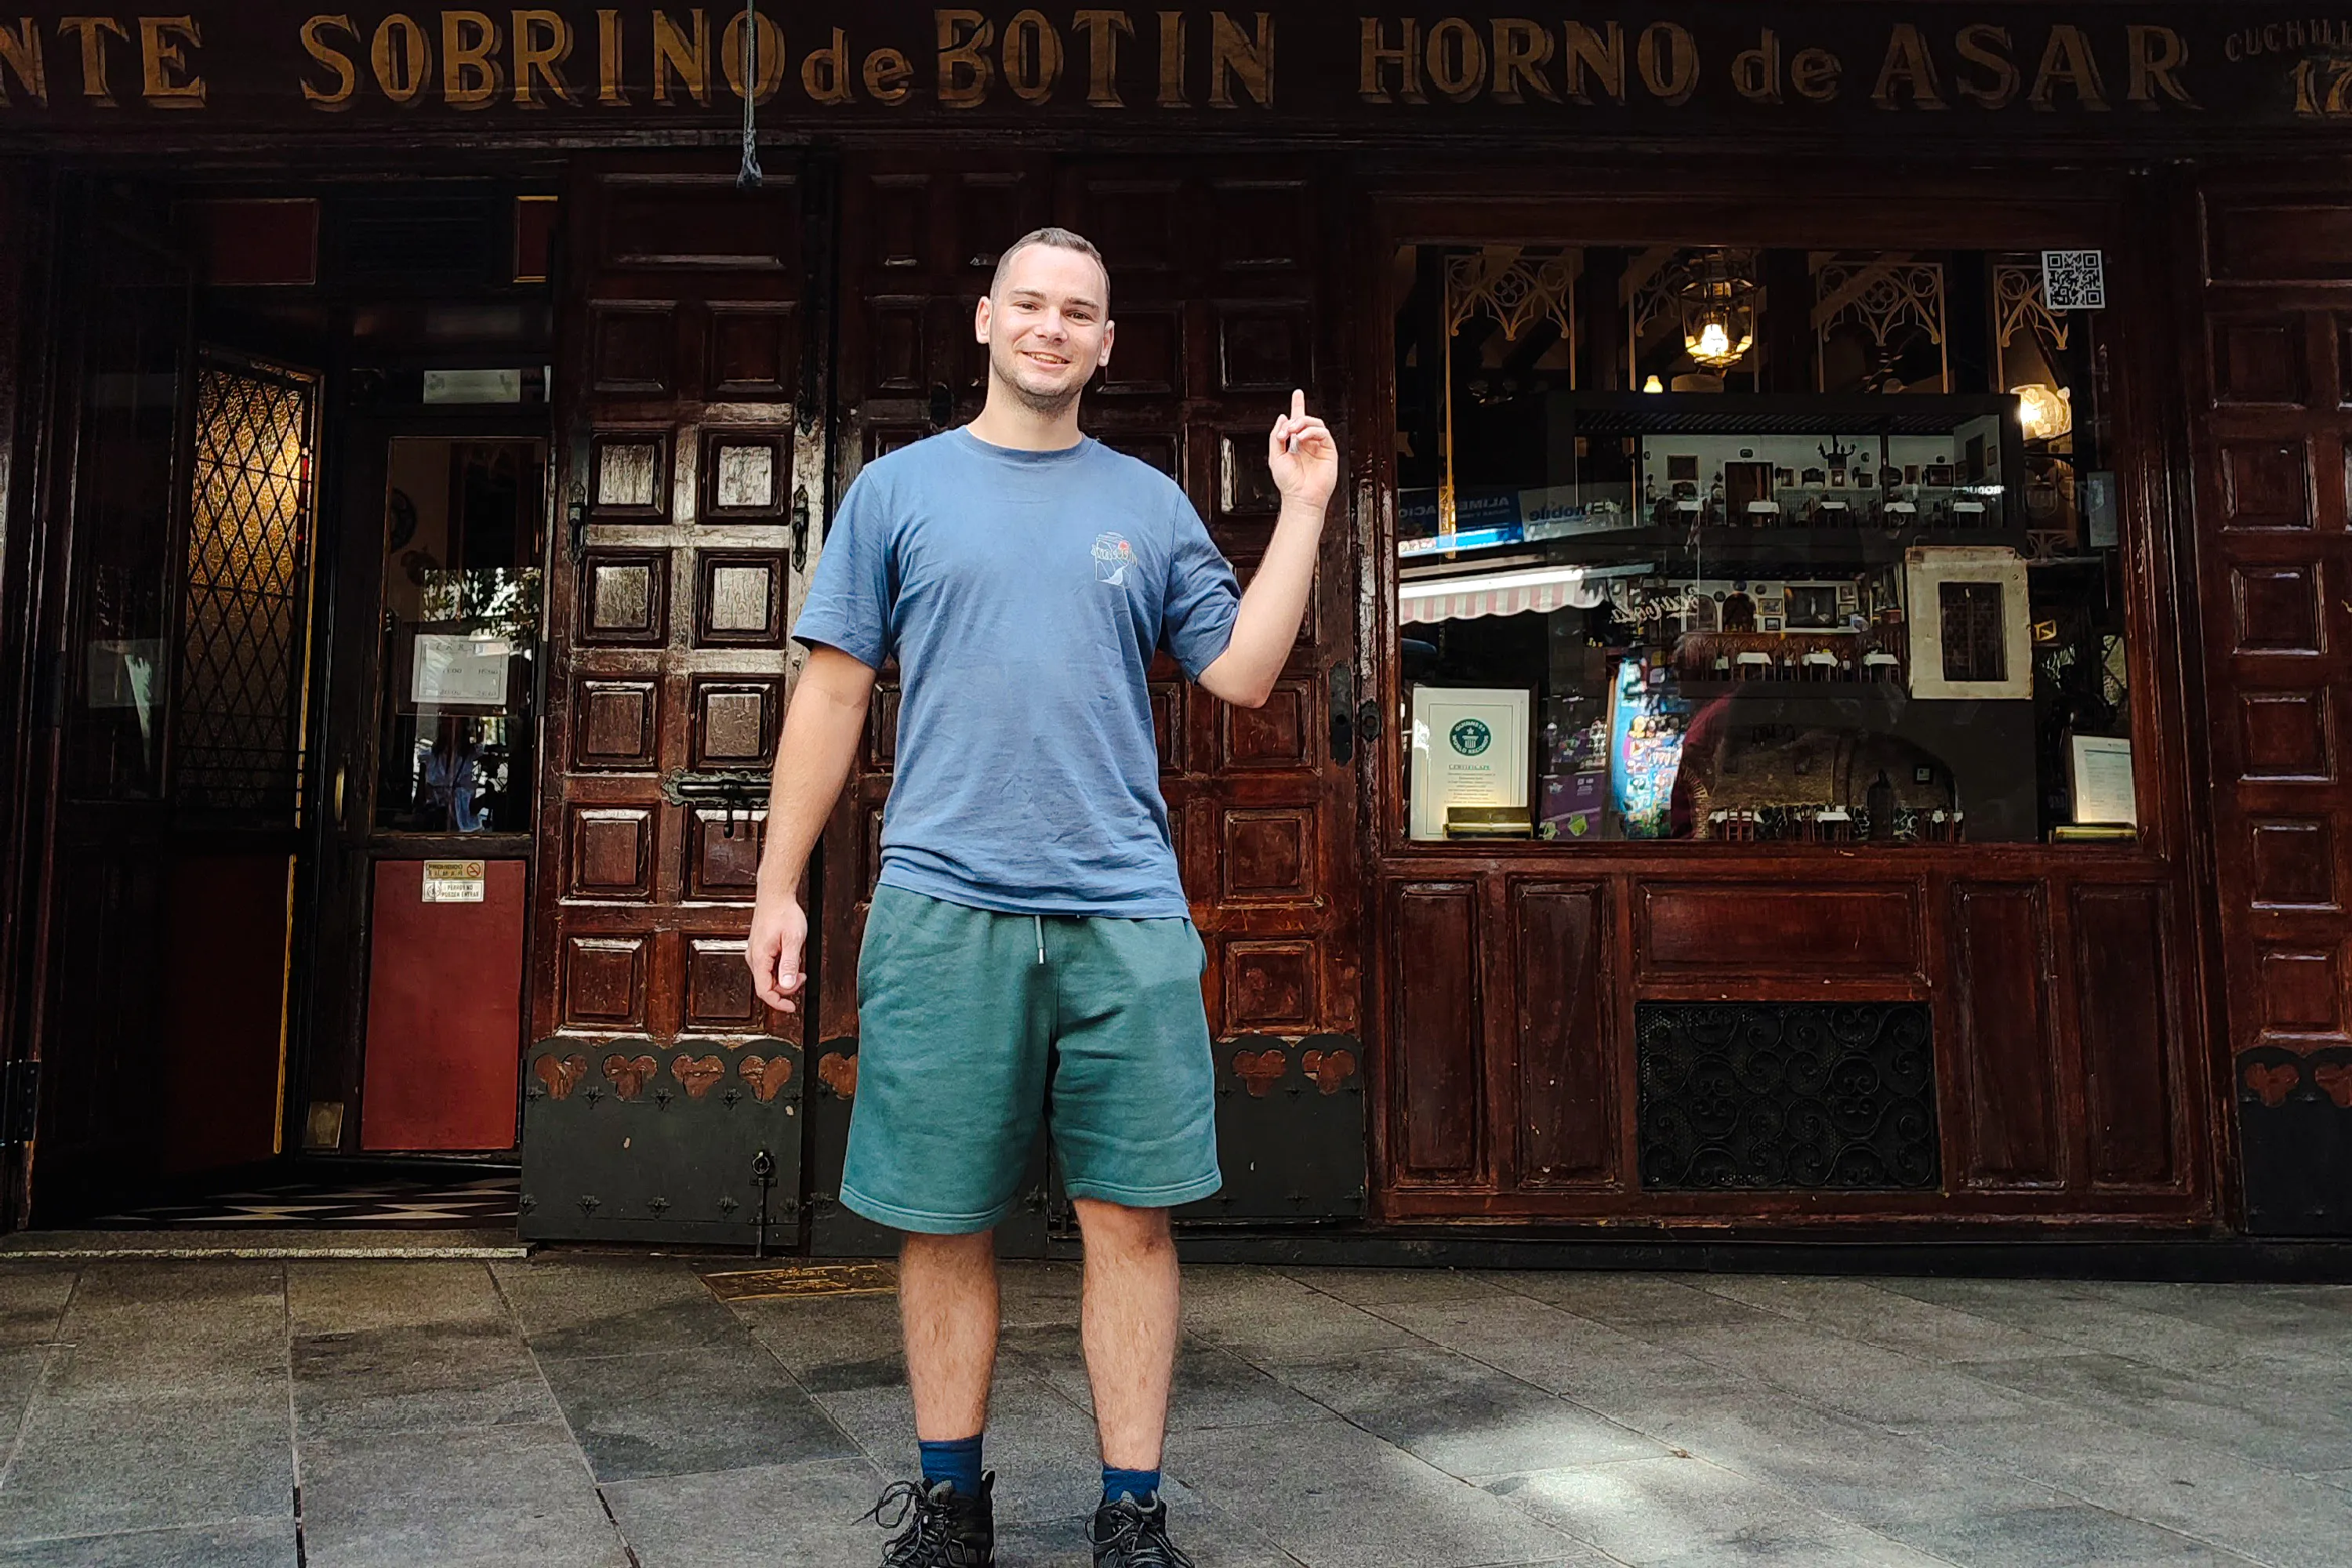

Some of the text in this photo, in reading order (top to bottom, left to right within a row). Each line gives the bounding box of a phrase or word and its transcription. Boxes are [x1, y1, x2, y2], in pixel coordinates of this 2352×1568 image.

[0, 9, 2205, 111] NTE SOBRINO de BOTIN HORNO de ASAR
[2288, 57, 2352, 118] 17
